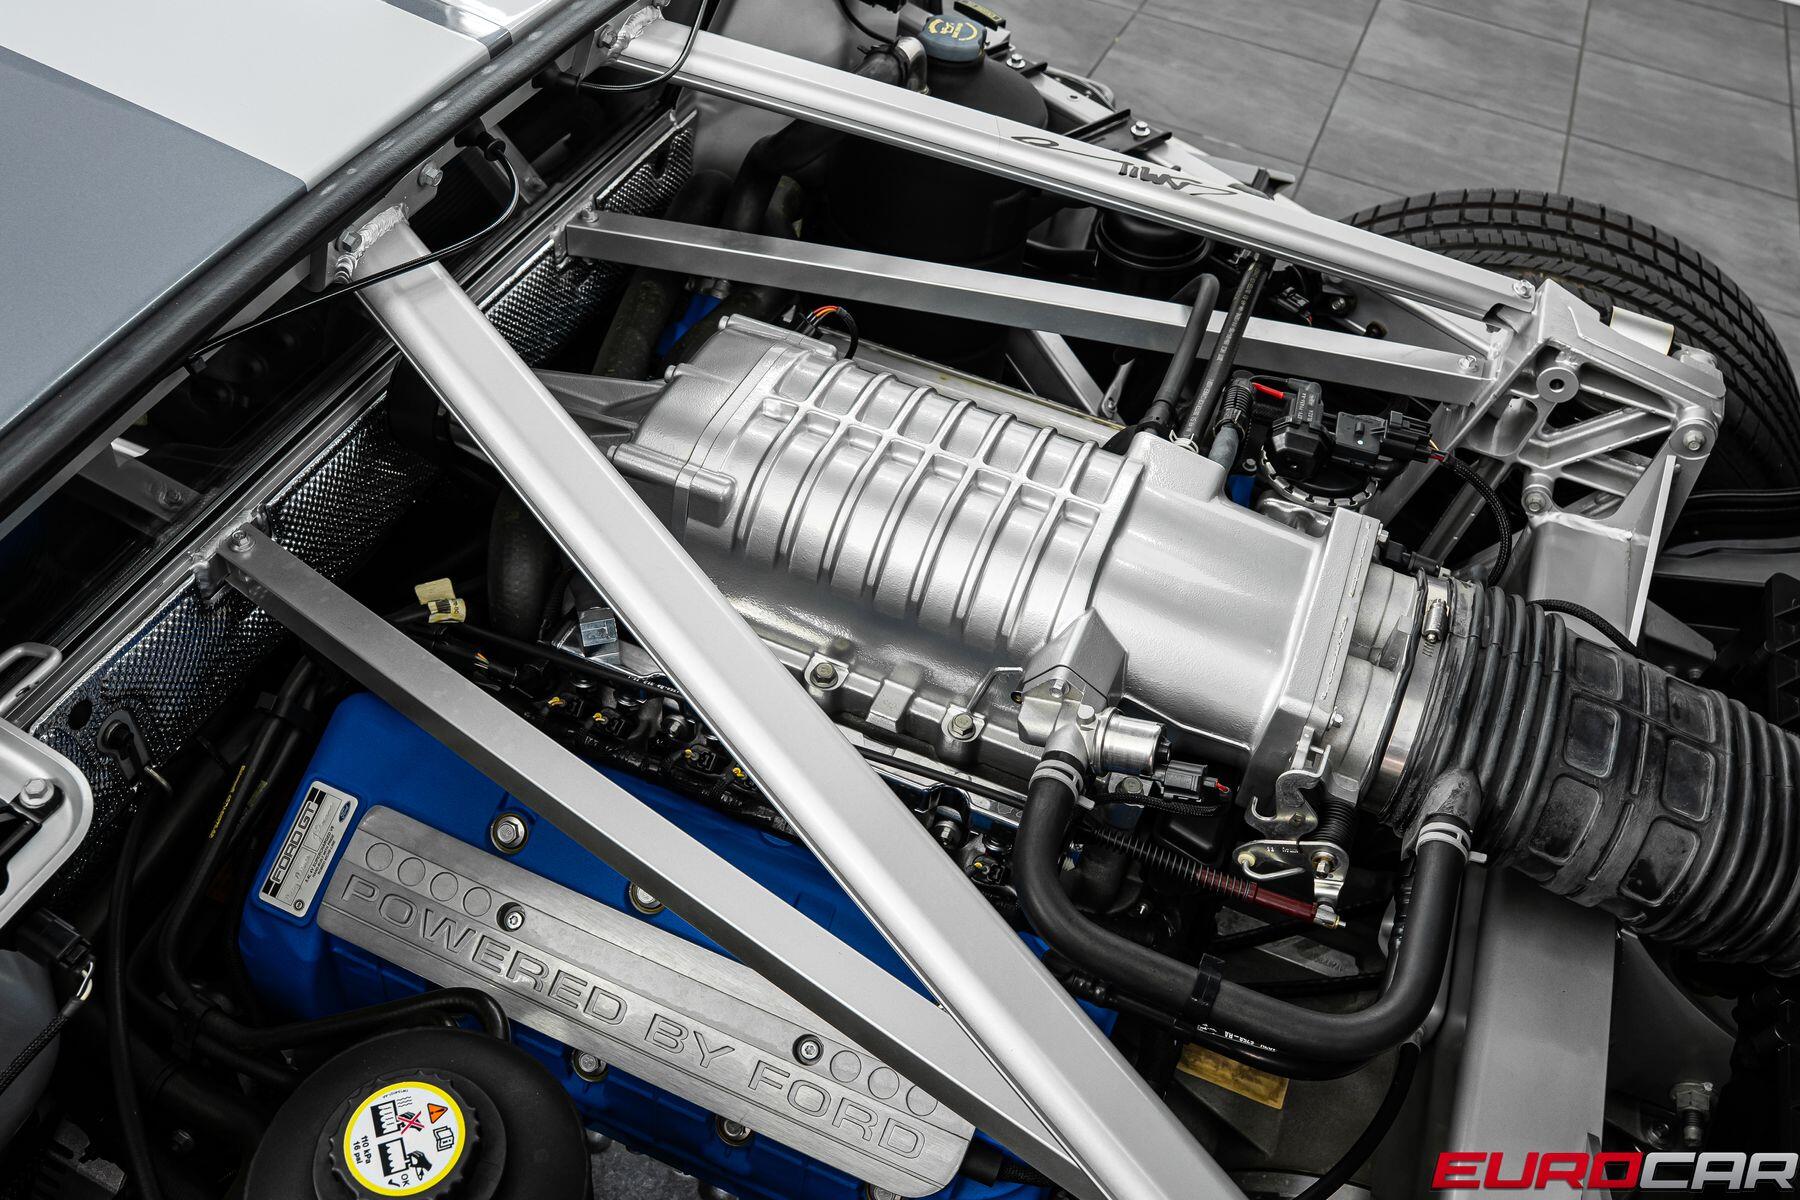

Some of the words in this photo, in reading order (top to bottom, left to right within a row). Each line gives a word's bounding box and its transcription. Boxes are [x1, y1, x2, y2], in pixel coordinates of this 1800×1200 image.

[272, 831, 303, 882] FORD
[298, 802, 314, 829] GT
[341, 874, 628, 1026] POWERED
[644, 1013, 735, 1068] BY
[748, 1060, 926, 1159] FORD
[353, 1141, 361, 1150] 16
[361, 1135, 369, 1147] 110
[401, 1173, 410, 1187] OK
